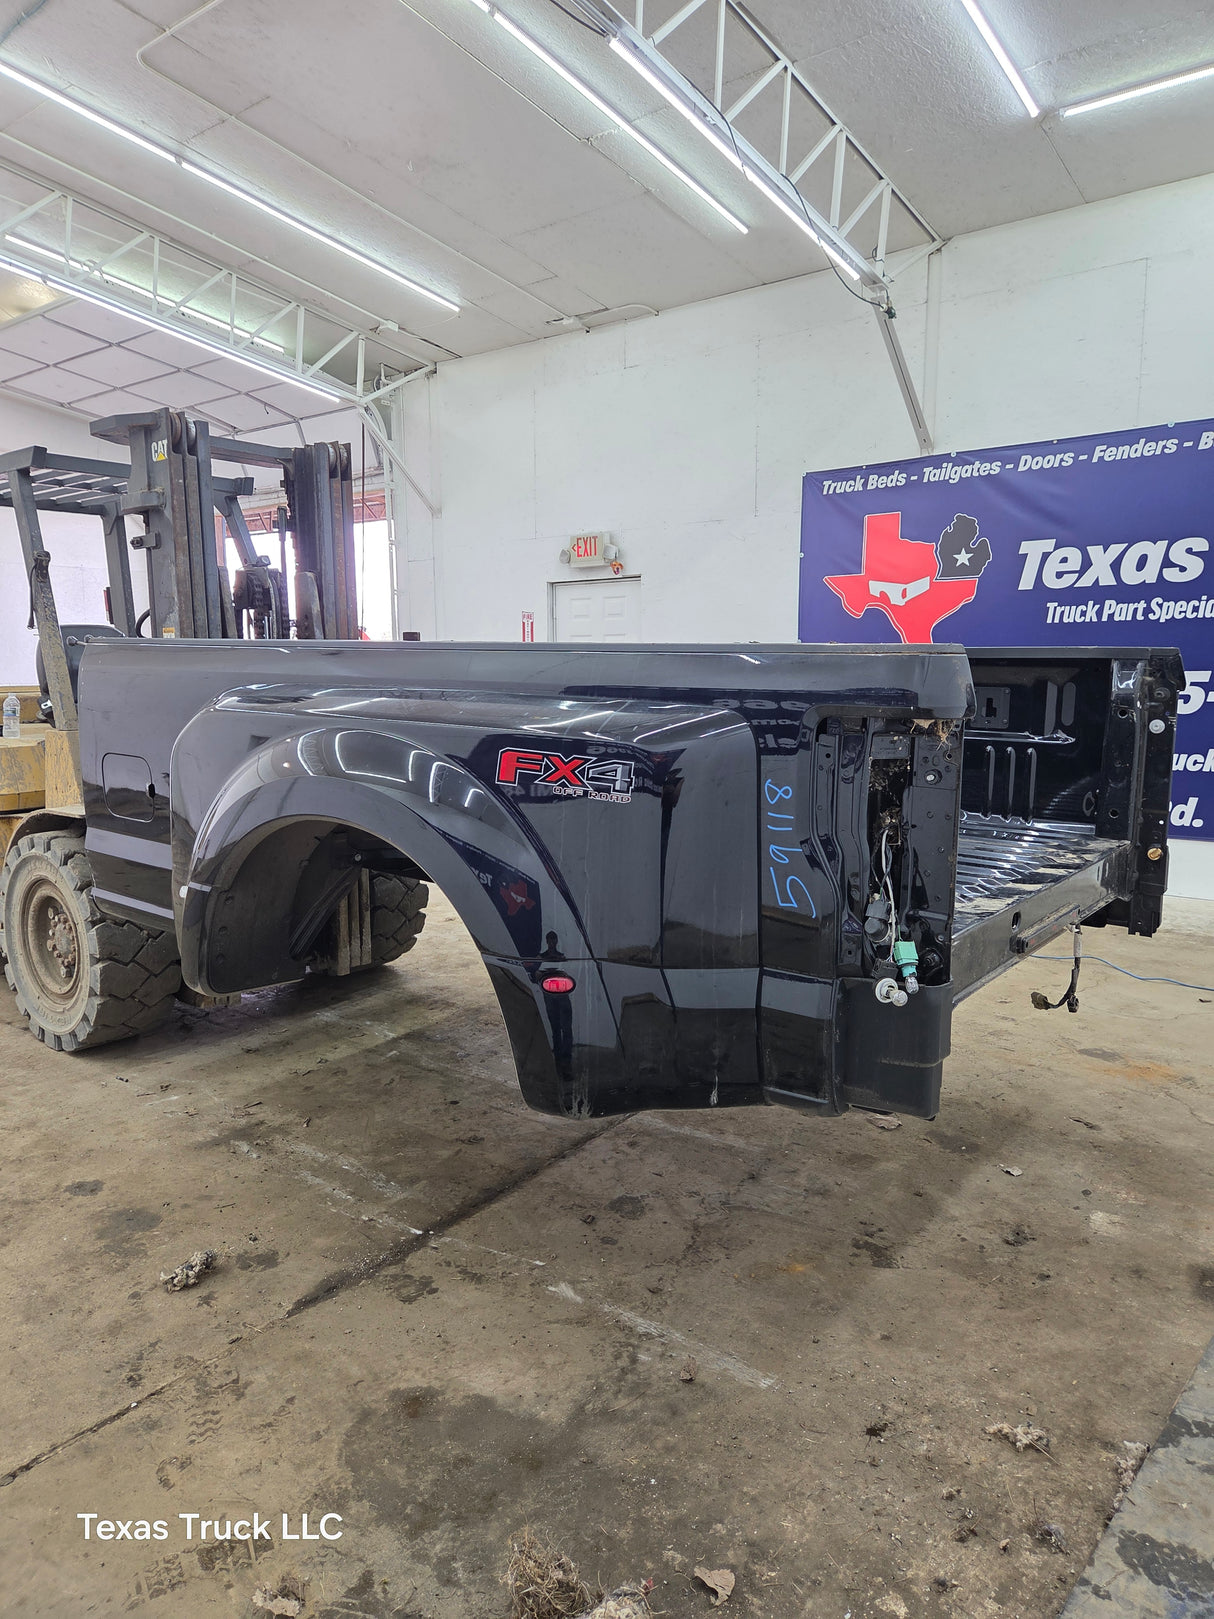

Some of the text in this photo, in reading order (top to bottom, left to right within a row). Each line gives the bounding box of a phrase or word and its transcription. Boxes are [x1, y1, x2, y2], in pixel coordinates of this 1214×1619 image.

[151, 438, 168, 462] CAT
[822, 475, 865, 495] Truck
[867, 470, 907, 490] Beds
[922, 461, 1001, 484] Tailgates
[1017, 451, 1075, 472] Doors
[1092, 438, 1179, 463] Fenders
[1197, 431, 1214, 450] B
[576, 536, 598, 557] EXIT
[1017, 537, 1210, 590] Texas
[1046, 600, 1101, 623] Truck
[1101, 599, 1147, 622] Part
[495, 747, 636, 796] FX4
[1172, 748, 1214, 772] uck
[552, 786, 584, 797] OFF
[588, 790, 632, 804] ROAD
[1169, 797, 1204, 828] d.
